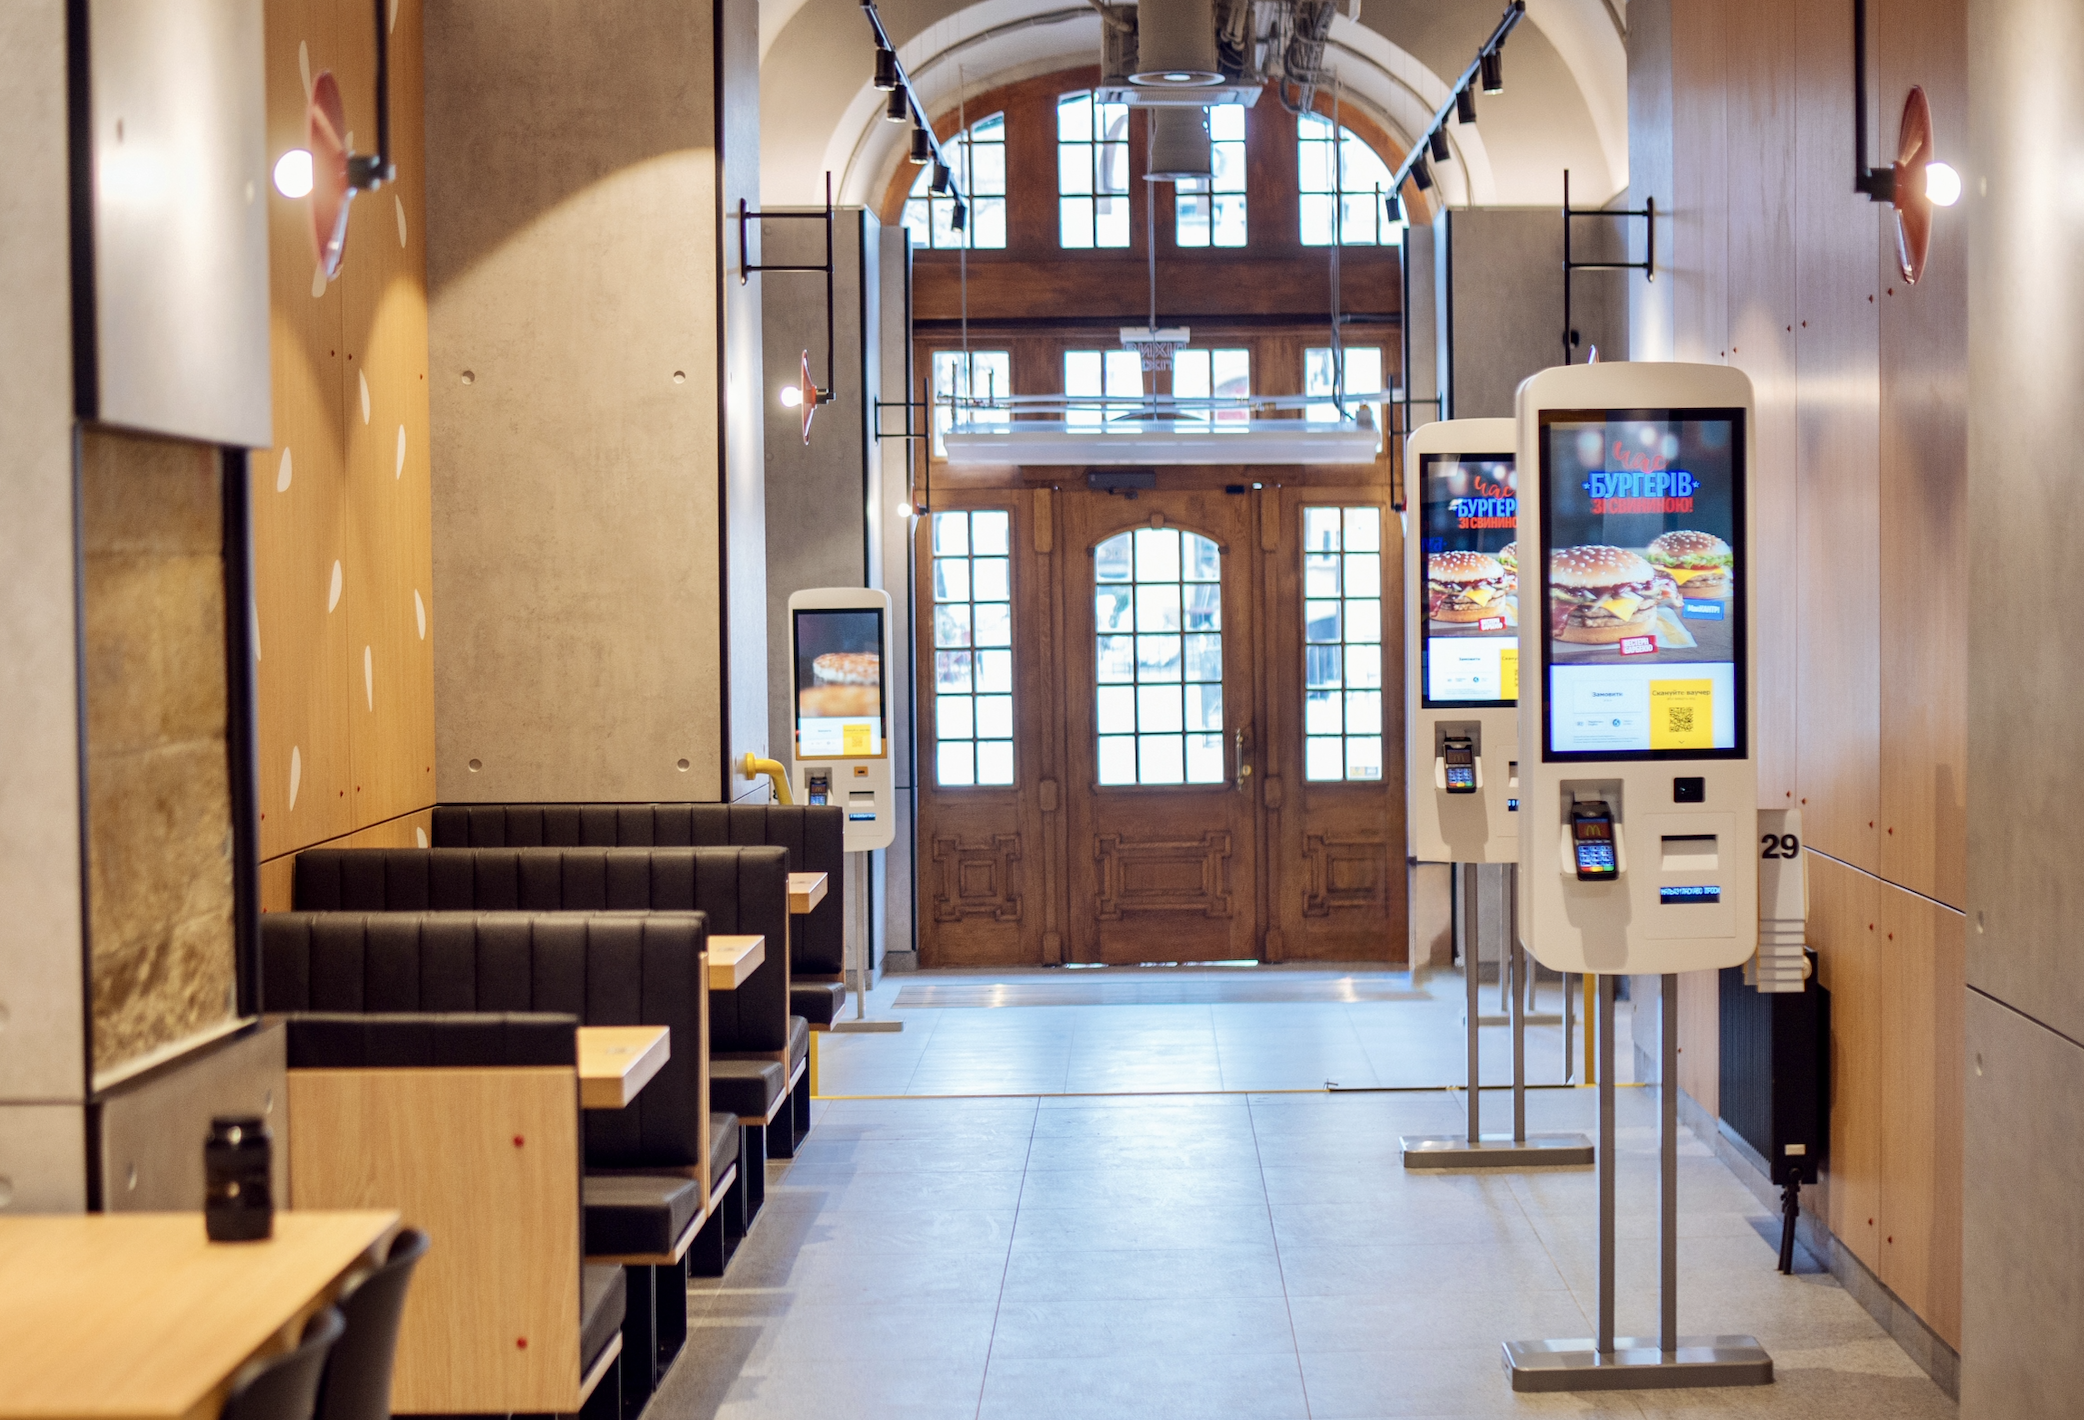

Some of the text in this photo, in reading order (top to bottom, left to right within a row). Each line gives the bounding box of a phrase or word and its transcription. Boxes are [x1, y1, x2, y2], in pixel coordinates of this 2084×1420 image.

[1590, 471, 1694, 499] БУРГЕРІВ
[1608, 497, 1694, 514] СВИНИНОЮ!
[1761, 833, 1800, 859] 29
